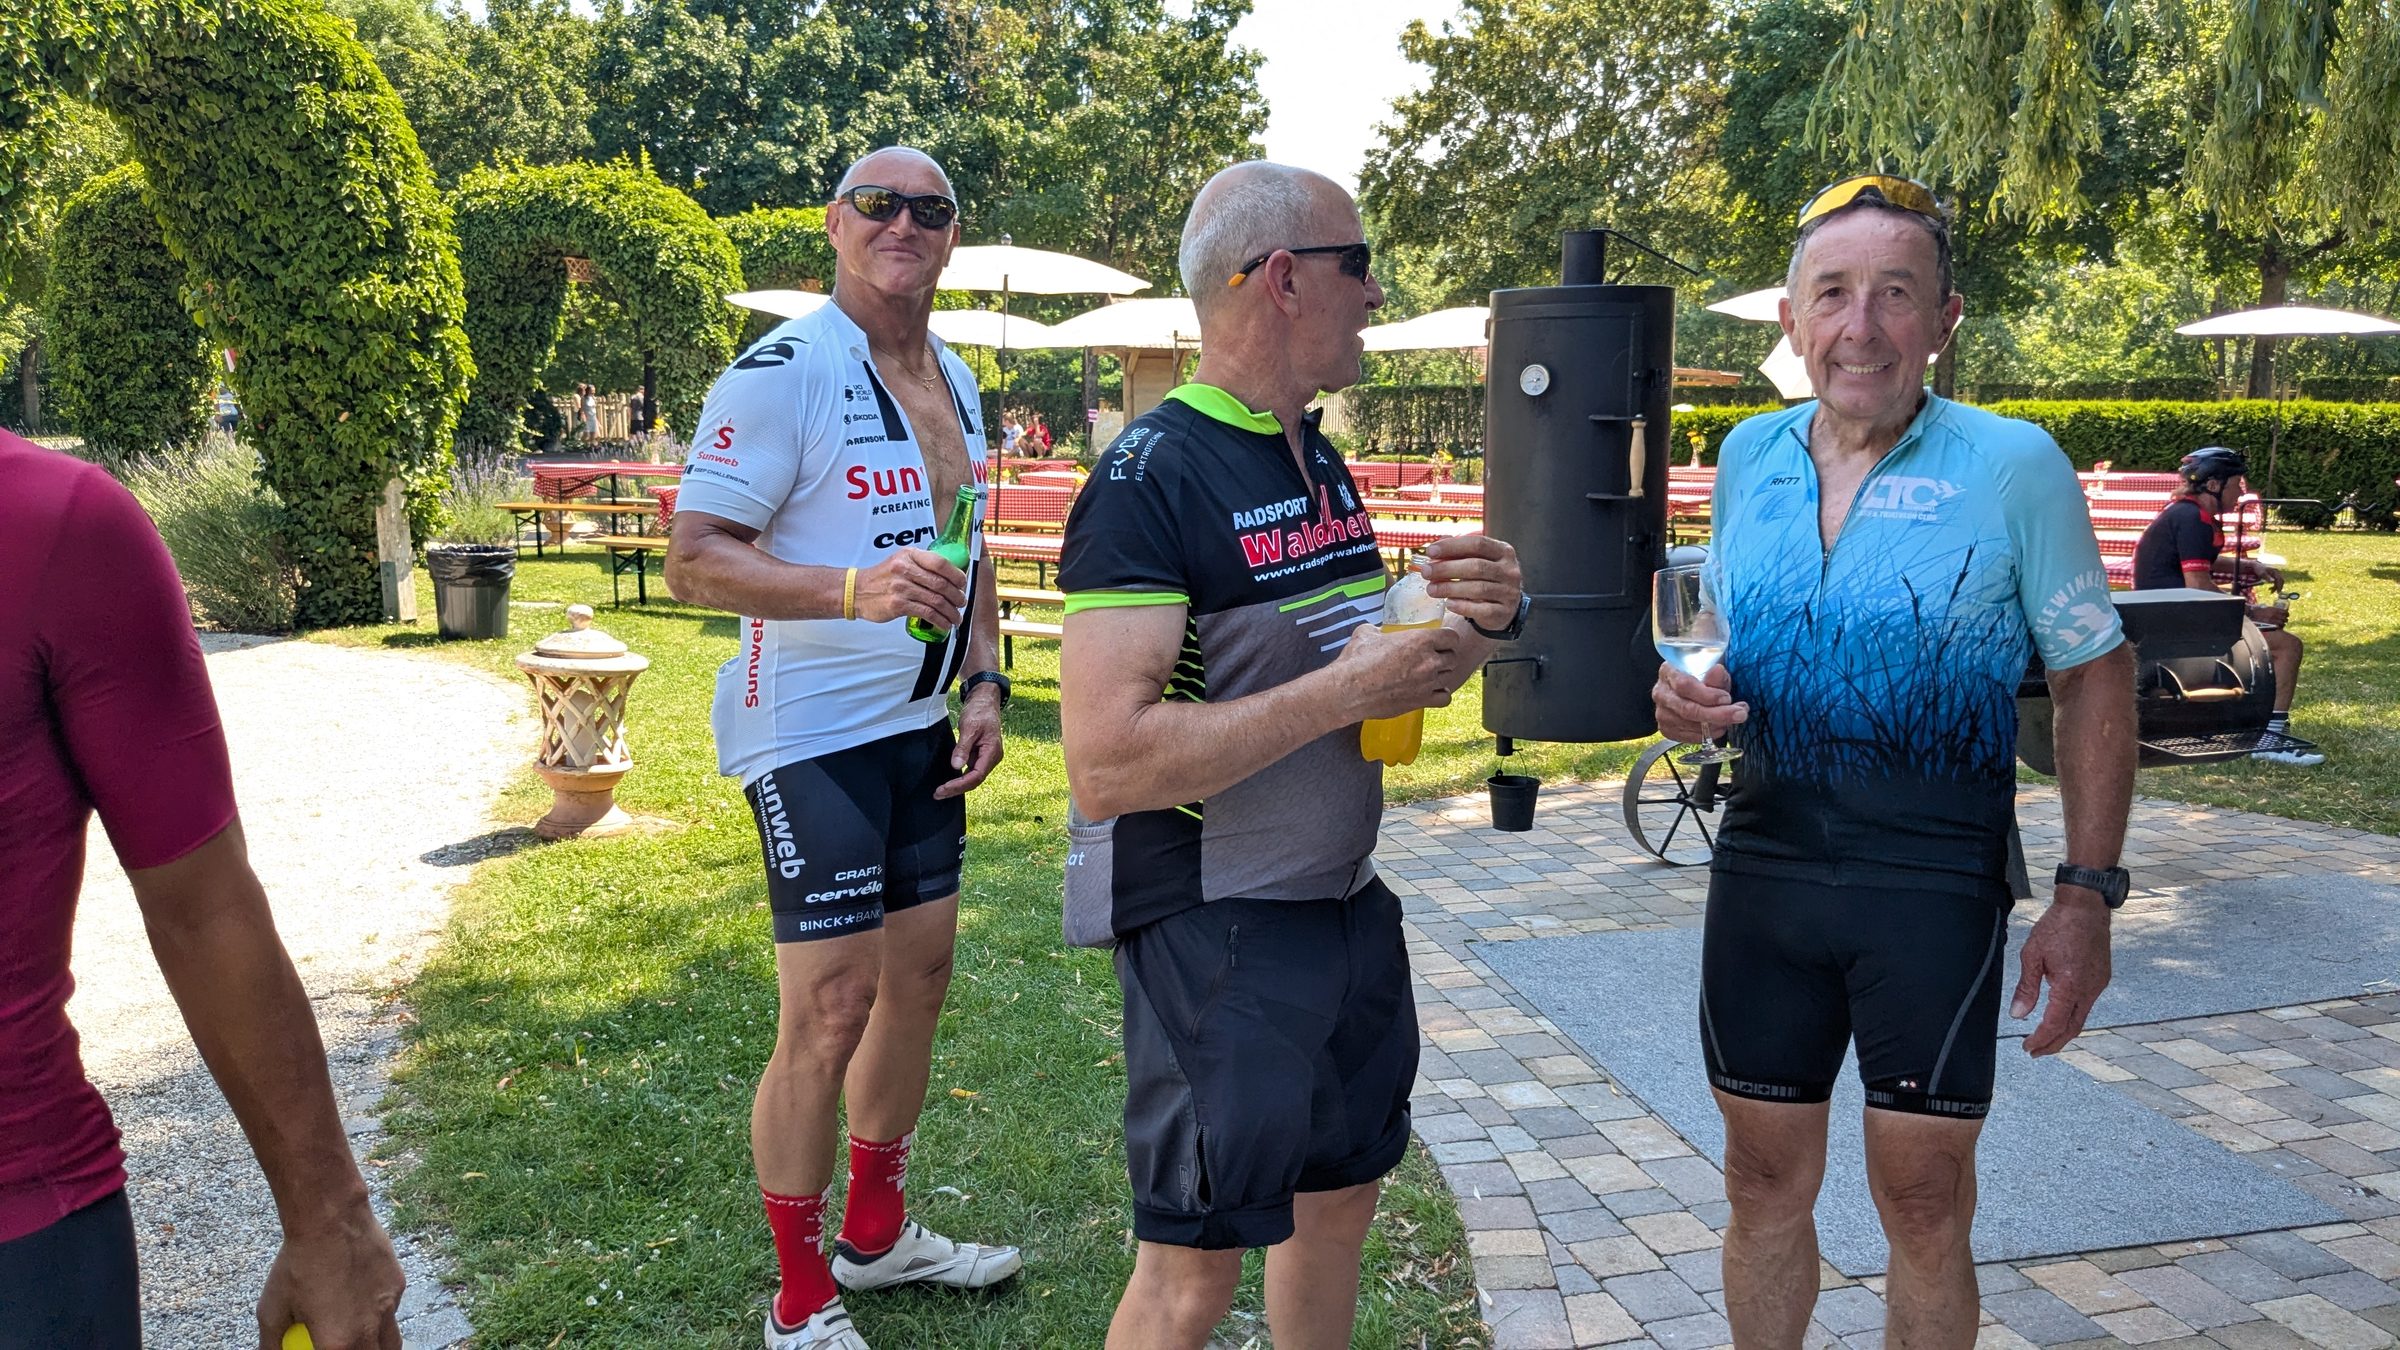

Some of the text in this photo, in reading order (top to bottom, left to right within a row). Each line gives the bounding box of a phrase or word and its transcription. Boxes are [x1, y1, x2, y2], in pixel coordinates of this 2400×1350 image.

[854, 435, 885, 445] RENSON
[697, 451, 739, 467] Sunweb
[846, 465, 924, 500] Sun
[1770, 476, 1801, 486] RH77
[872, 498, 931, 516] #CREATING
[1232, 496, 1308, 530] RADSPORT
[761, 772, 806, 879] unweb
[835, 865, 878, 881] CRAFT
[805, 880, 883, 903] cervélo
